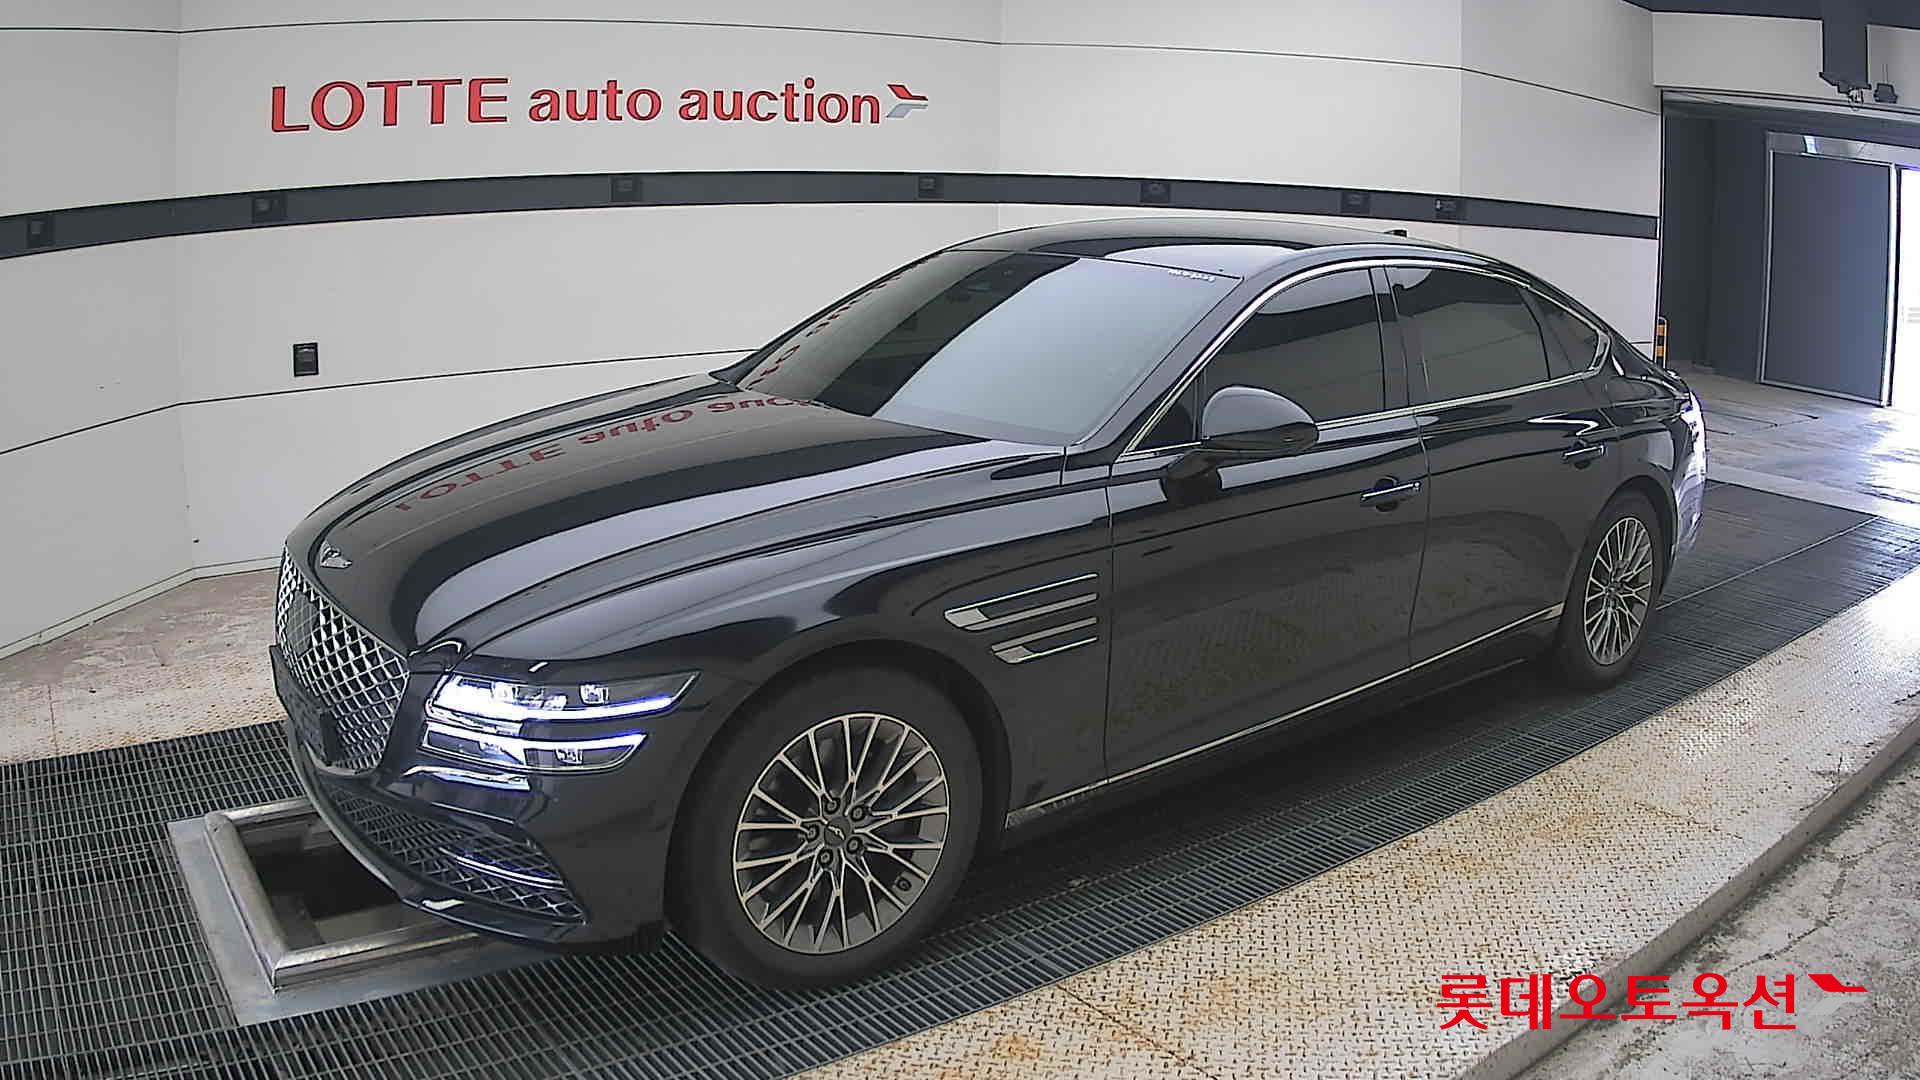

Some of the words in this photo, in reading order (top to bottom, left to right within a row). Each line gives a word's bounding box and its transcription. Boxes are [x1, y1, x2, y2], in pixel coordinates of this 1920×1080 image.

[270, 77, 508, 132] LOTTE
[528, 79, 662, 122] auto
[677, 77, 881, 124] auction
